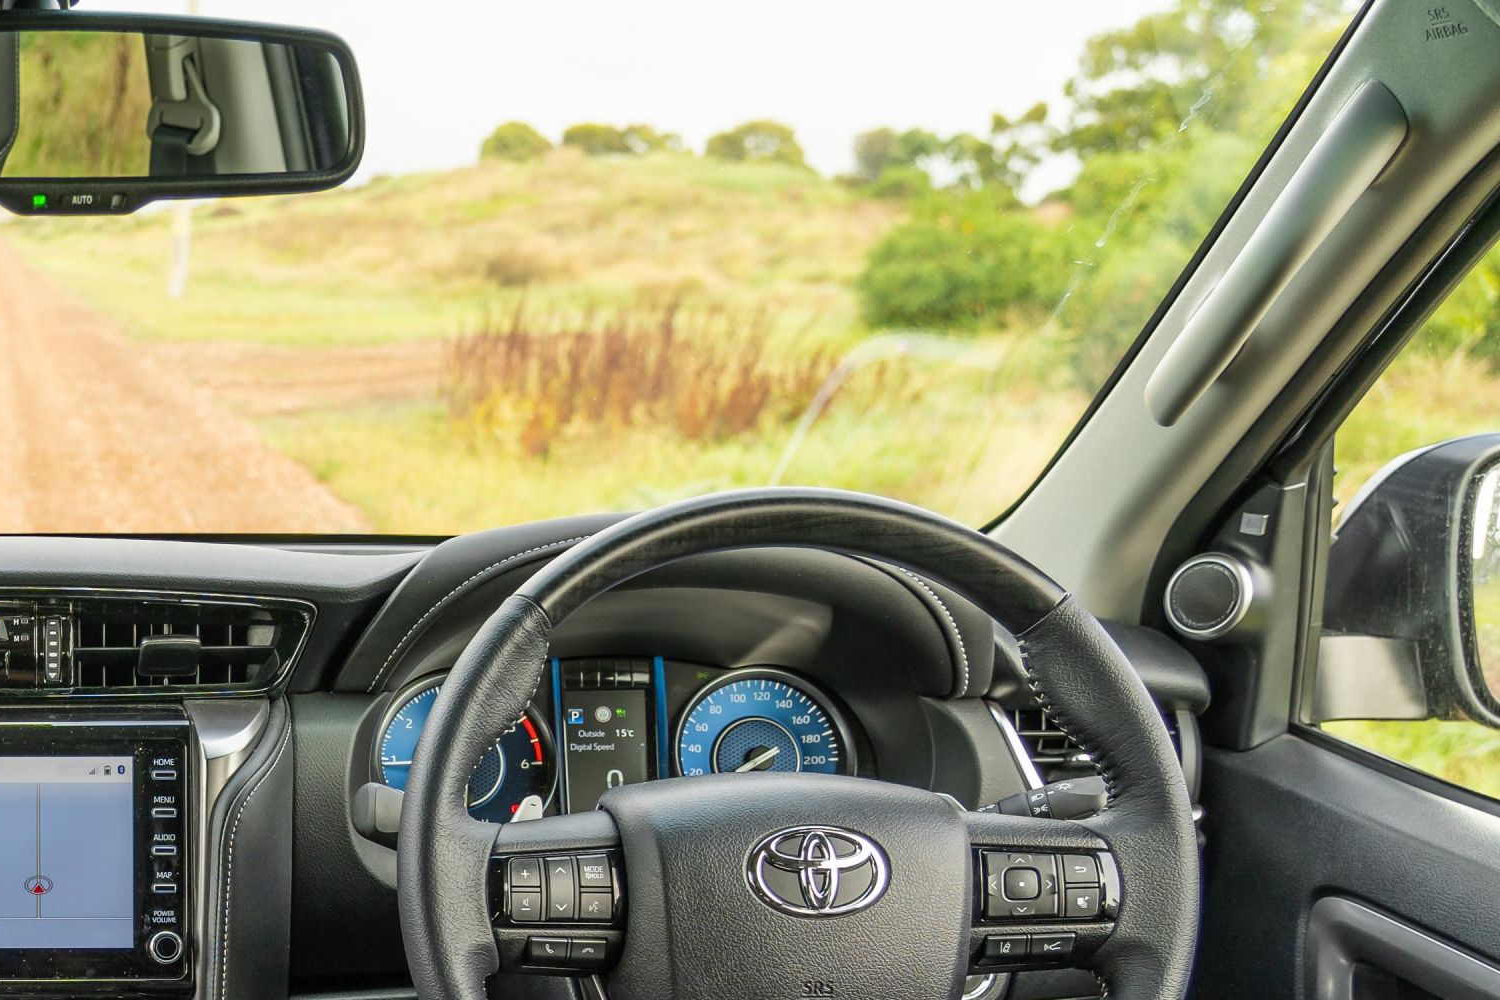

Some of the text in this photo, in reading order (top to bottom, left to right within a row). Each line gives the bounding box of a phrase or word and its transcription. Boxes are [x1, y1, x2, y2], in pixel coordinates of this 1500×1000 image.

[1427, 7, 1450, 21] SRS
[1425, 22, 1468, 42] AIRBAG
[71, 195, 93, 205] AUTO
[13, 618, 20, 626] H
[13, 634, 20, 643] M
[730, 694, 747, 704] 100
[753, 692, 770, 701] 120
[775, 699, 793, 709] 140
[709, 705, 722, 715] 80
[405, 718, 413, 729] 2
[791, 715, 811, 725] 160
[695, 722, 708, 733] 60
[577, 729, 605, 738] Outside
[800, 734, 821, 744] 180
[570, 742, 615, 752] Digital Speed
[688, 744, 702, 753] 40
[153, 758, 175, 766] HOME
[520, 758, 530, 769] 6
[803, 755, 826, 765] 200
[689, 767, 703, 776] 20
[153, 796, 175, 804] MENU
[153, 833, 176, 841] AUDIO
[583, 865, 604, 873] MODE
[156, 871, 172, 879] MAP
[801, 980, 834, 995] SRS
